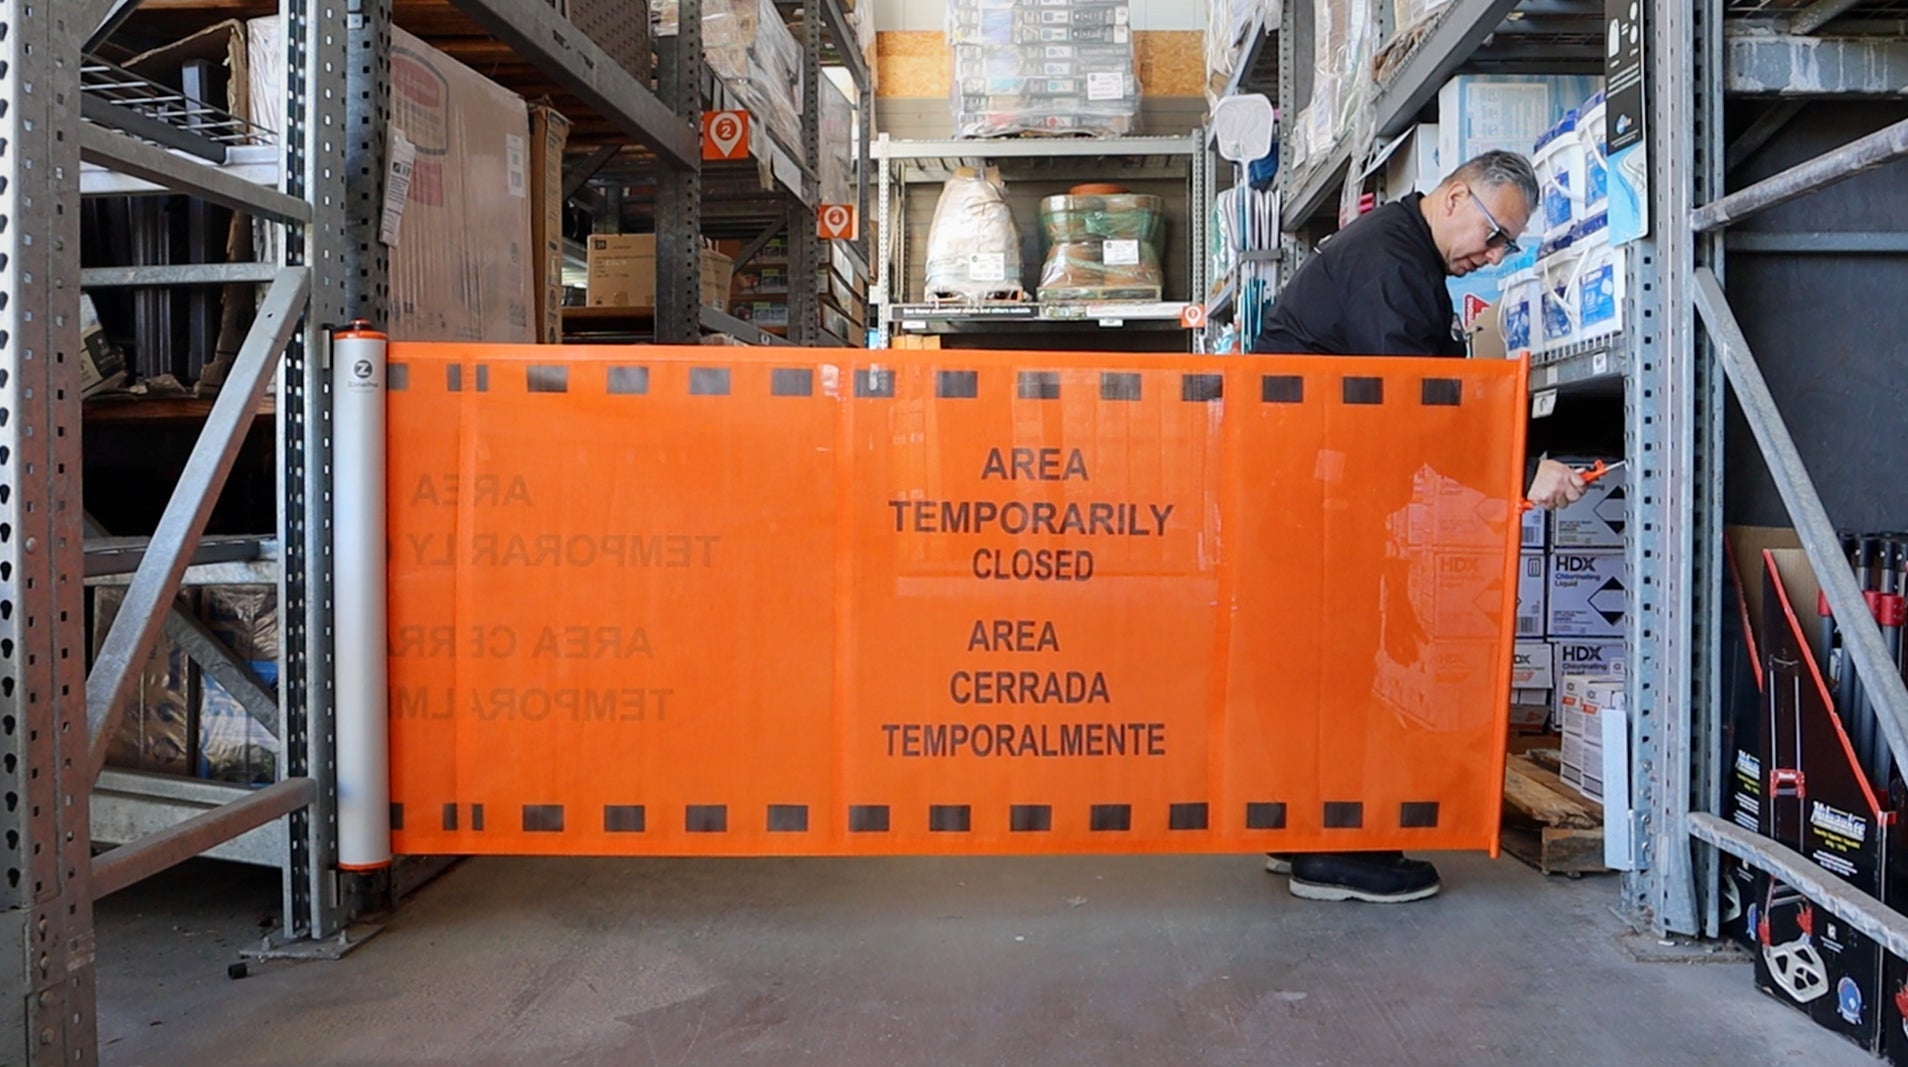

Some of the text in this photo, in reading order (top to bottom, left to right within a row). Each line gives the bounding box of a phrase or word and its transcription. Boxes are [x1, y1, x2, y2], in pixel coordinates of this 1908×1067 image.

[721, 125, 732, 138] 2
[981, 447, 1089, 481] AREA
[888, 500, 1175, 536] TEMPORARILY
[972, 548, 1094, 581] CLOSED
[1440, 557, 1479, 573] HDX
[1556, 556, 1596, 572] HDX
[967, 620, 1060, 651] AREA
[1562, 646, 1602, 662] HDX
[1562, 663, 1608, 672] Chlorinating
[950, 670, 1111, 704] CERRADA
[881, 722, 1166, 757] TEMPORALMENTE
